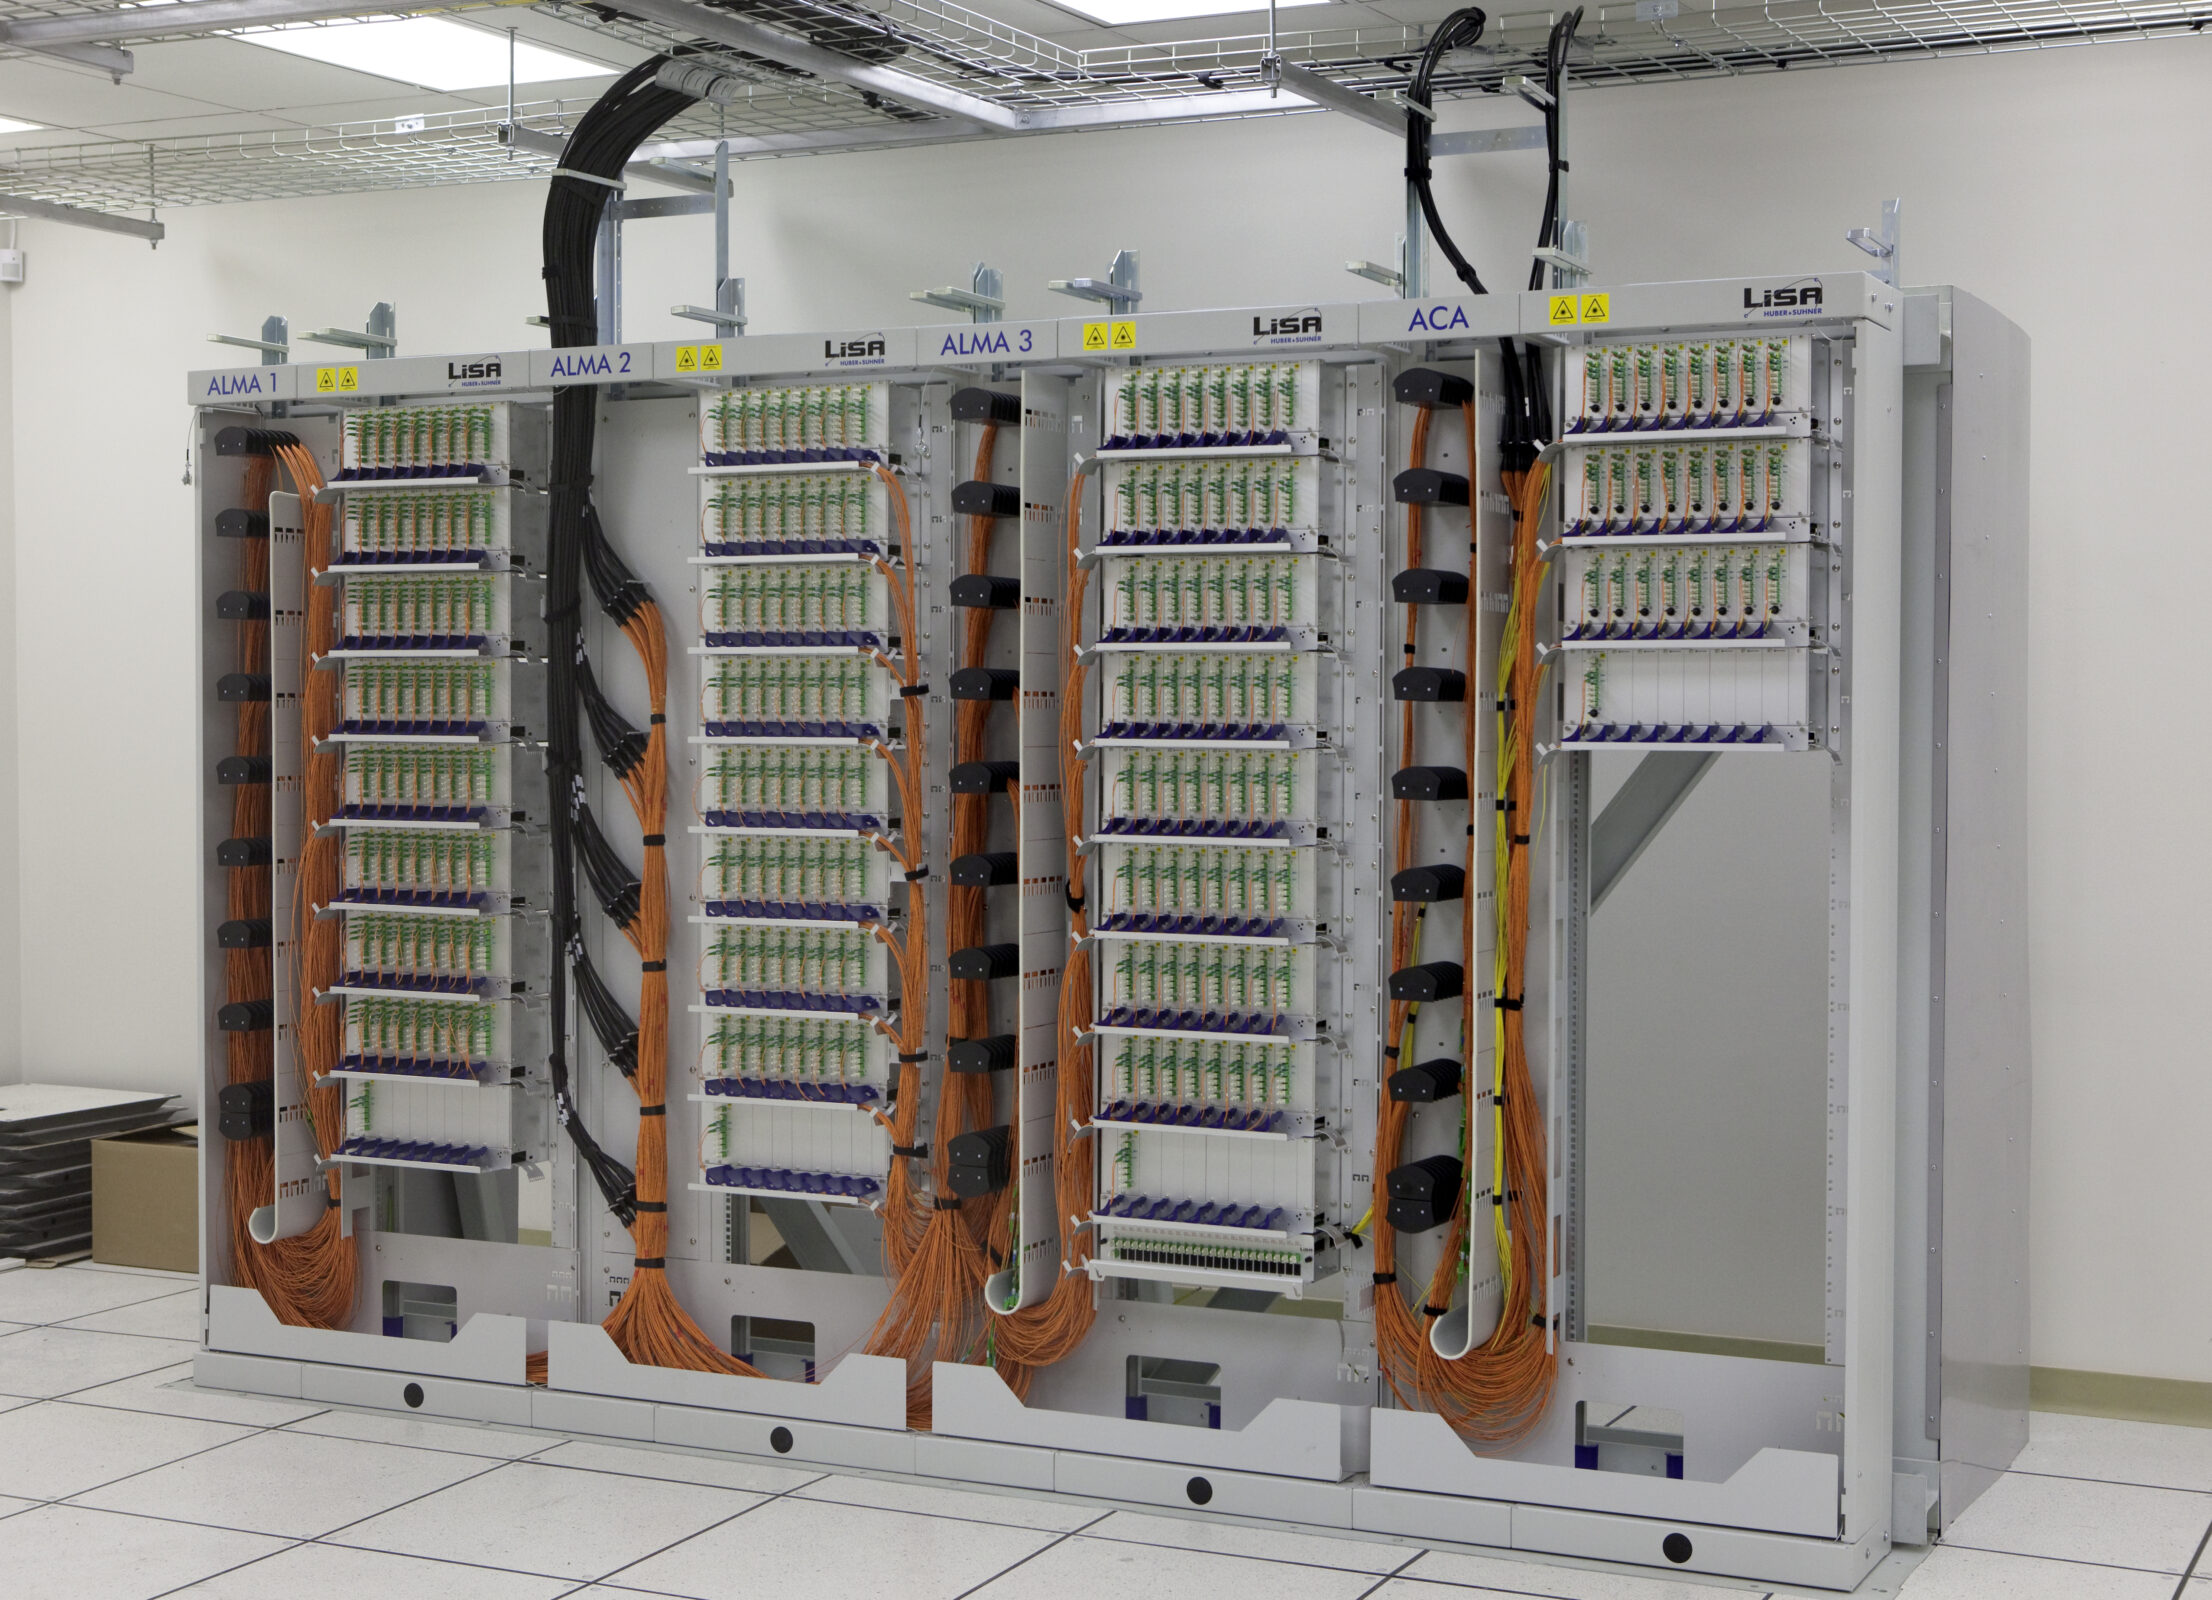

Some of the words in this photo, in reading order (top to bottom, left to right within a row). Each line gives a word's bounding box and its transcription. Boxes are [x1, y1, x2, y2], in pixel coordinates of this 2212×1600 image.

[1408, 305, 1470, 332] ACA
[940, 330, 1011, 356] ALMA
[1019, 329, 1032, 352] 3
[550, 353, 612, 377] ALMA
[619, 351, 631, 373] 2
[207, 373, 262, 396] ALMA
[270, 372, 276, 393] 1
